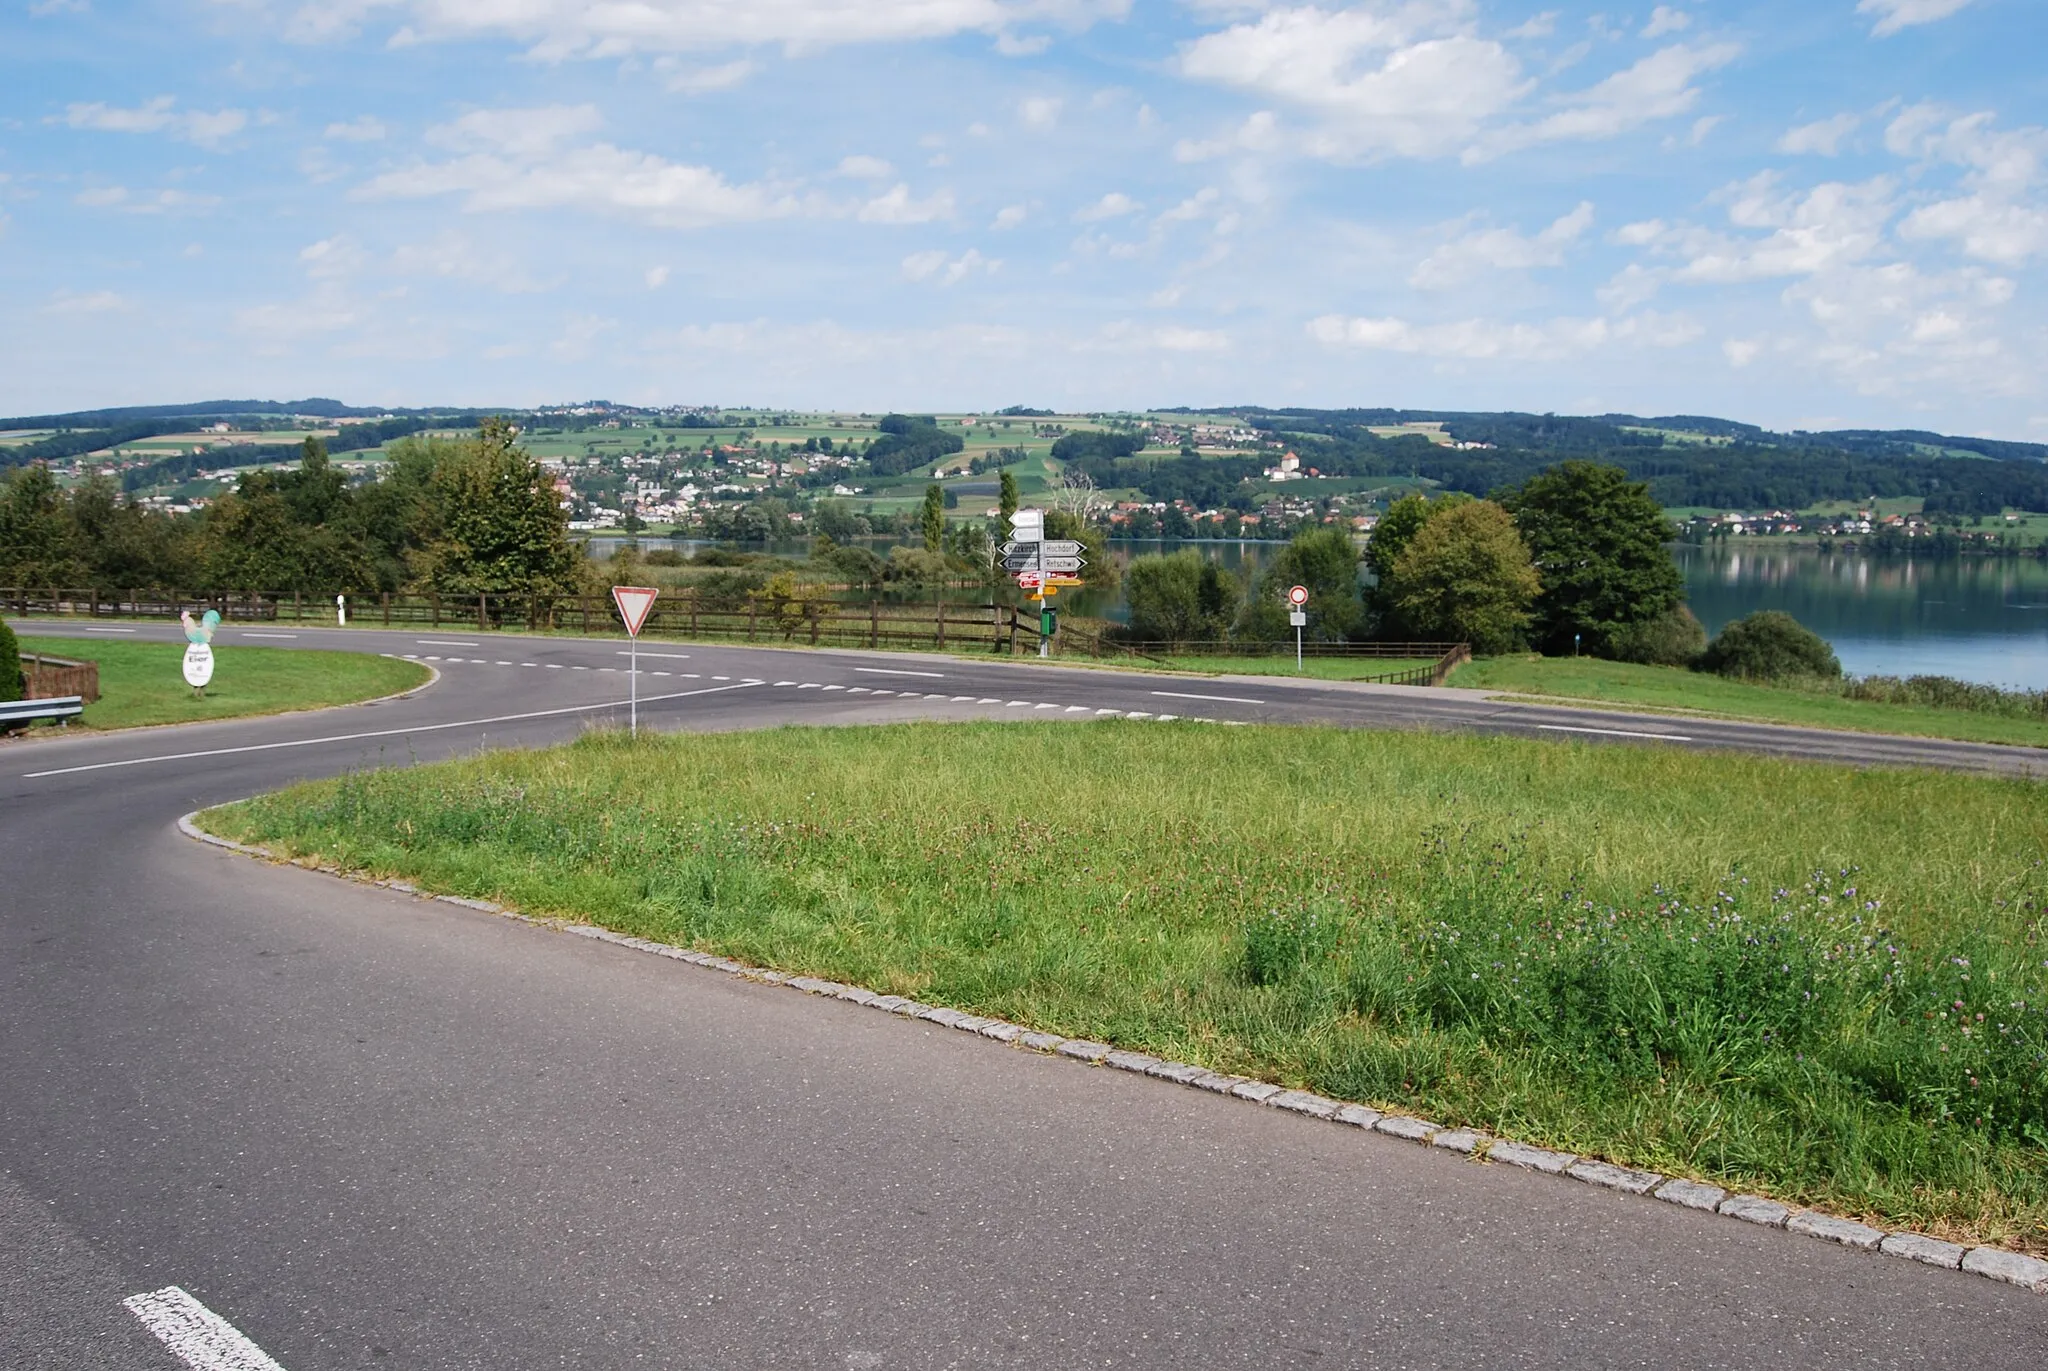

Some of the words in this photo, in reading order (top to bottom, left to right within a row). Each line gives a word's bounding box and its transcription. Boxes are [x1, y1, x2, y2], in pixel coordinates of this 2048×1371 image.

[1046, 543, 1075, 552] Hochdorf
[1046, 559, 1075, 568] Retschwil
[188, 655, 208, 663] Eier
